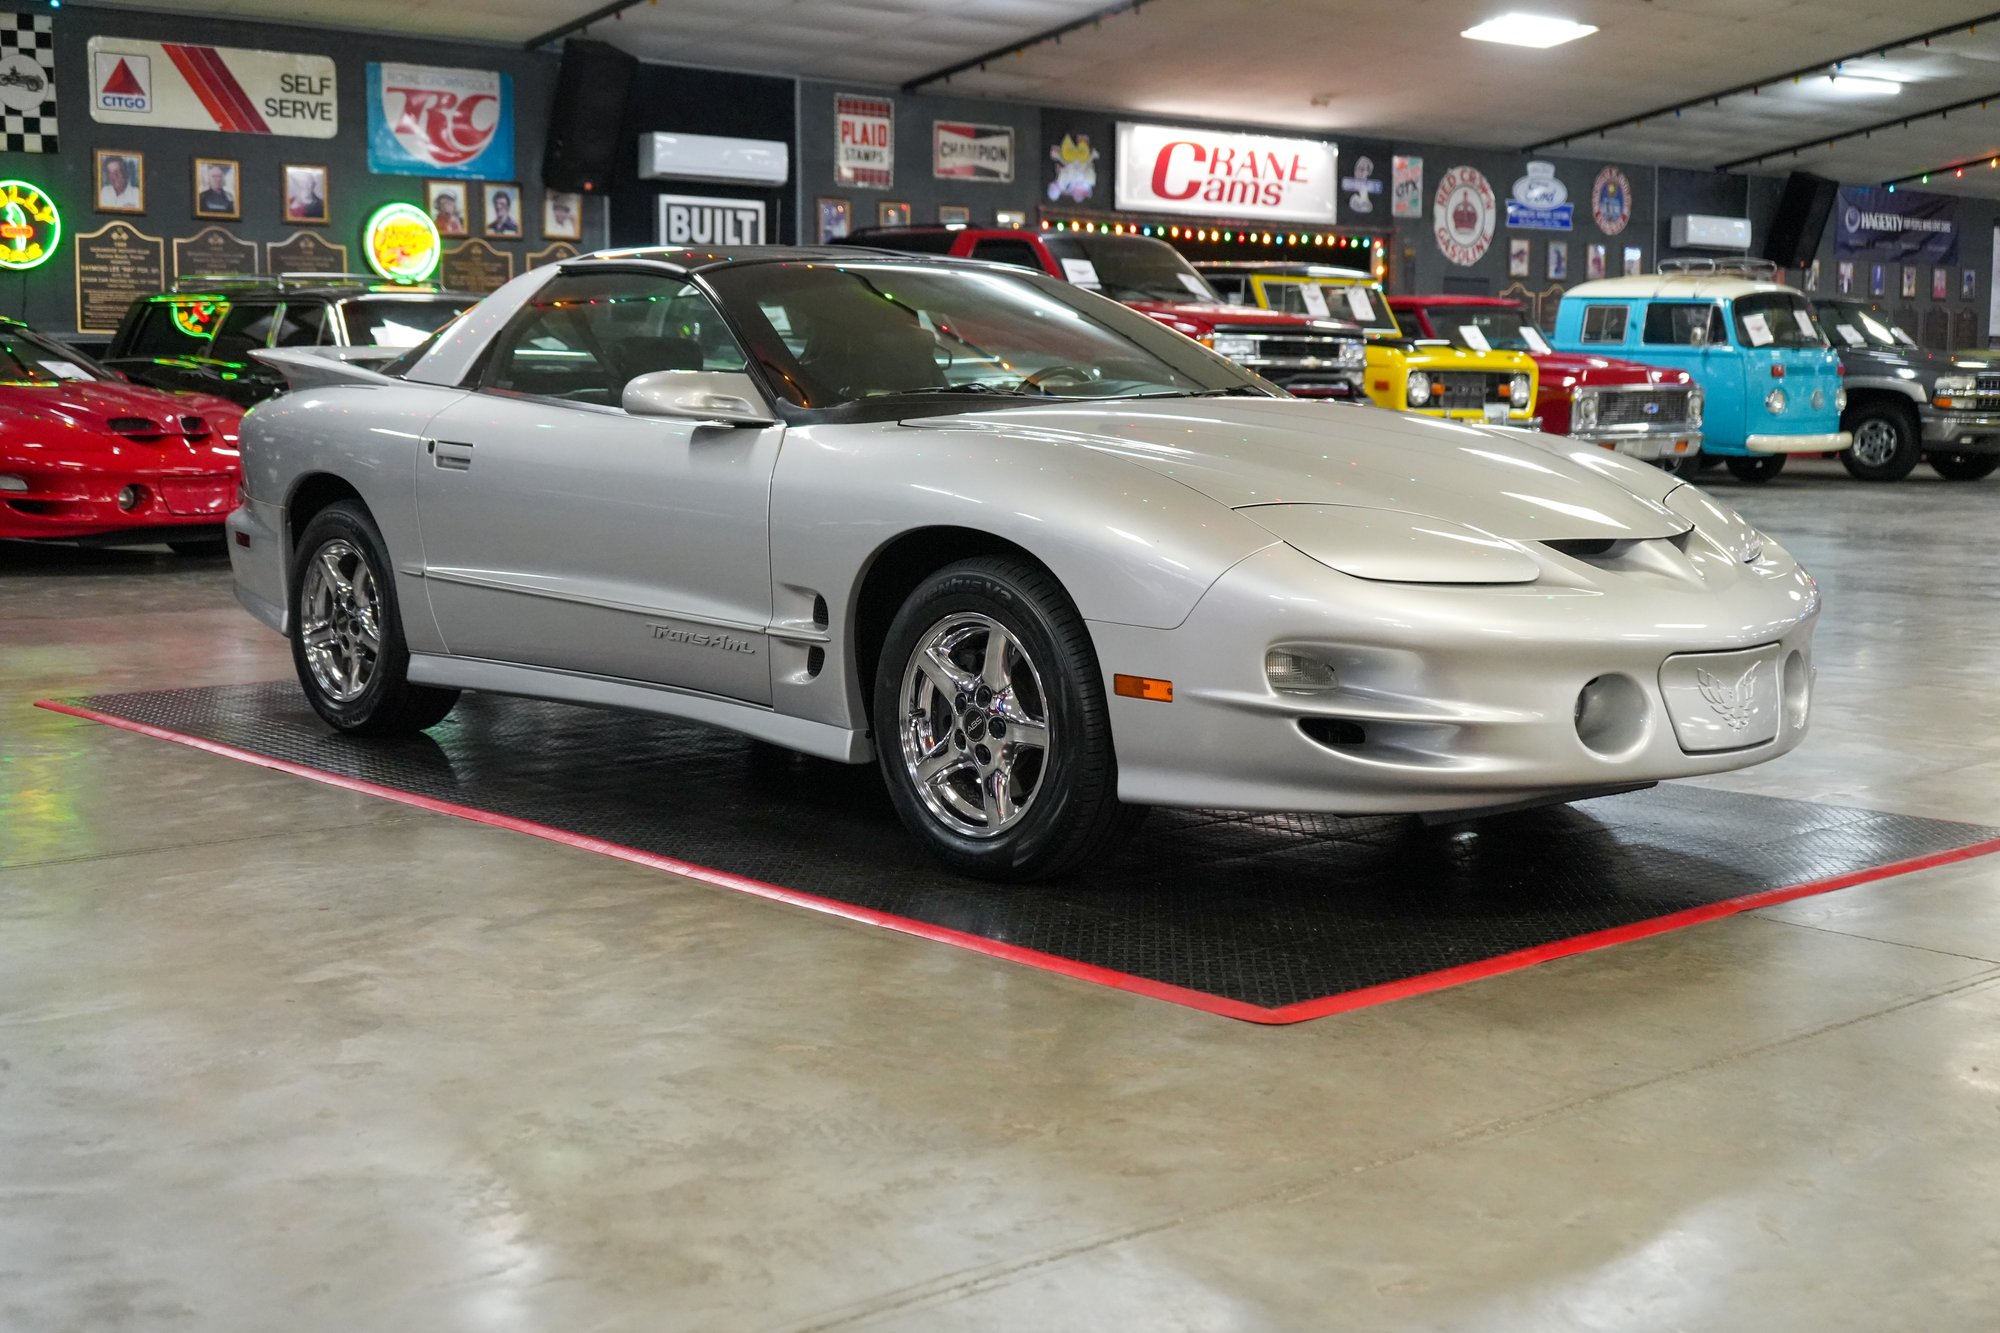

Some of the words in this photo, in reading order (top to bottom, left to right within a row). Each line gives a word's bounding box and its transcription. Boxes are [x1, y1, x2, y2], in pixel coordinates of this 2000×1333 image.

[280, 73, 332, 96] SELF
[102, 95, 146, 110] CITGO
[264, 99, 333, 121] SERVE
[386, 87, 497, 164] RC
[841, 120, 887, 147] PLAID
[844, 146, 883, 162] STAMPS
[941, 141, 1007, 162] CHAMPION
[1151, 141, 1309, 200] CRANE
[1436, 174, 1457, 207] RED
[670, 206, 756, 244] BUILT
[1861, 211, 1904, 232] HAGERTY
[1438, 227, 1493, 264] GASOLINE
[967, 716, 982, 734] ABS
